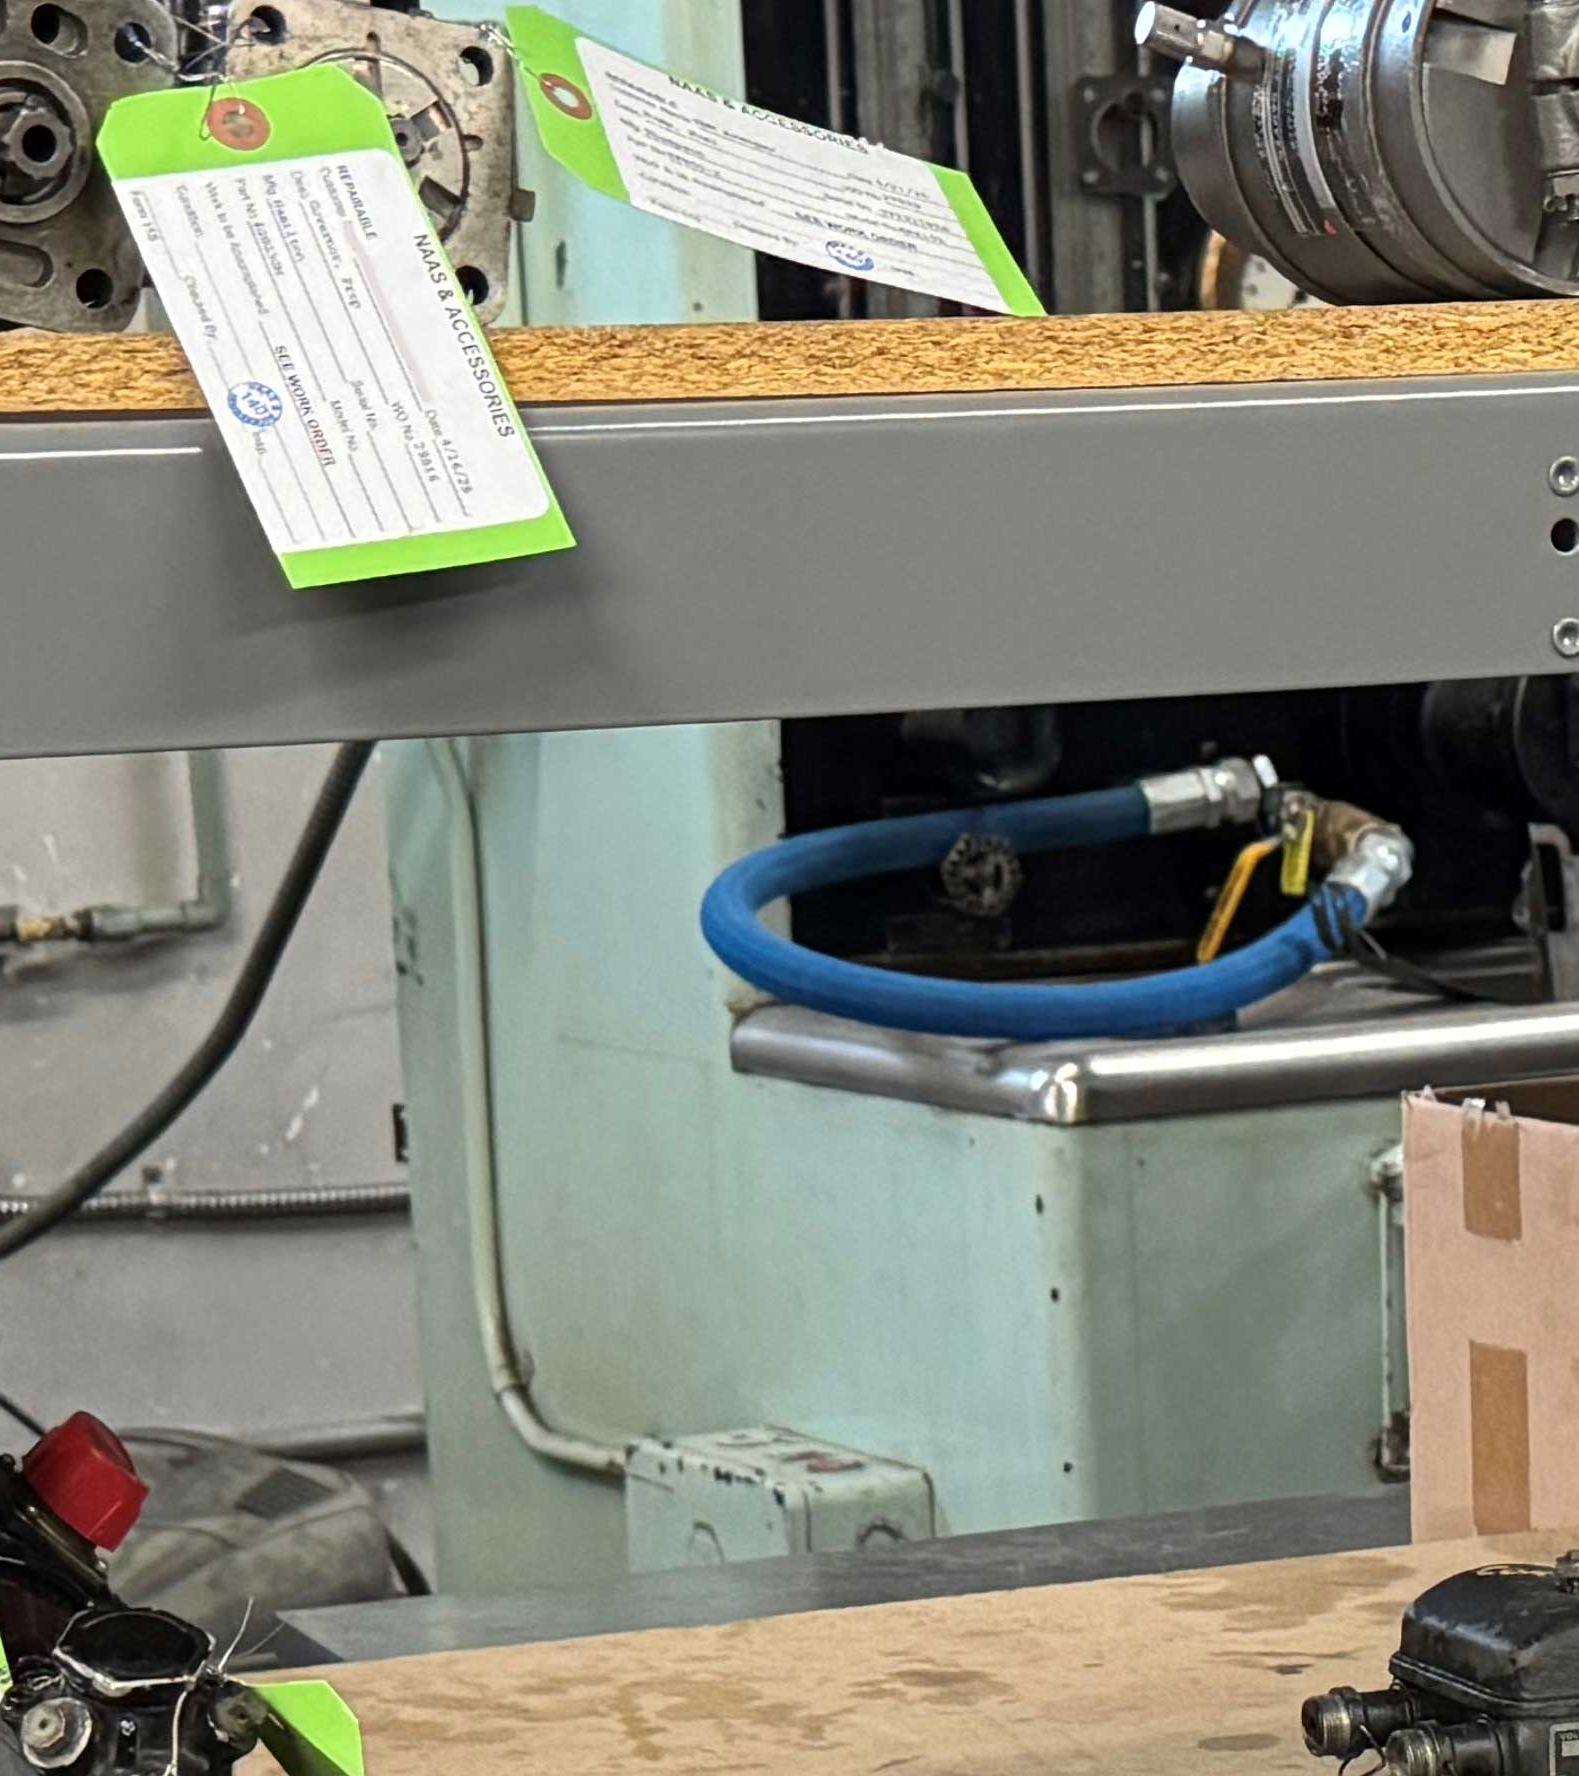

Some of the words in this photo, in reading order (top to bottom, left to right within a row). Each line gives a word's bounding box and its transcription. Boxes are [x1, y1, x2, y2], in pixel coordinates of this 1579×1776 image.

[337, 165, 377, 238] REPAIRABLE
[414, 234, 447, 283] NAAS
[437, 289, 454, 302] &
[445, 308, 514, 437] ACCESSORIES
[288, 374, 313, 416] WORK
[307, 419, 336, 466] ORDER
